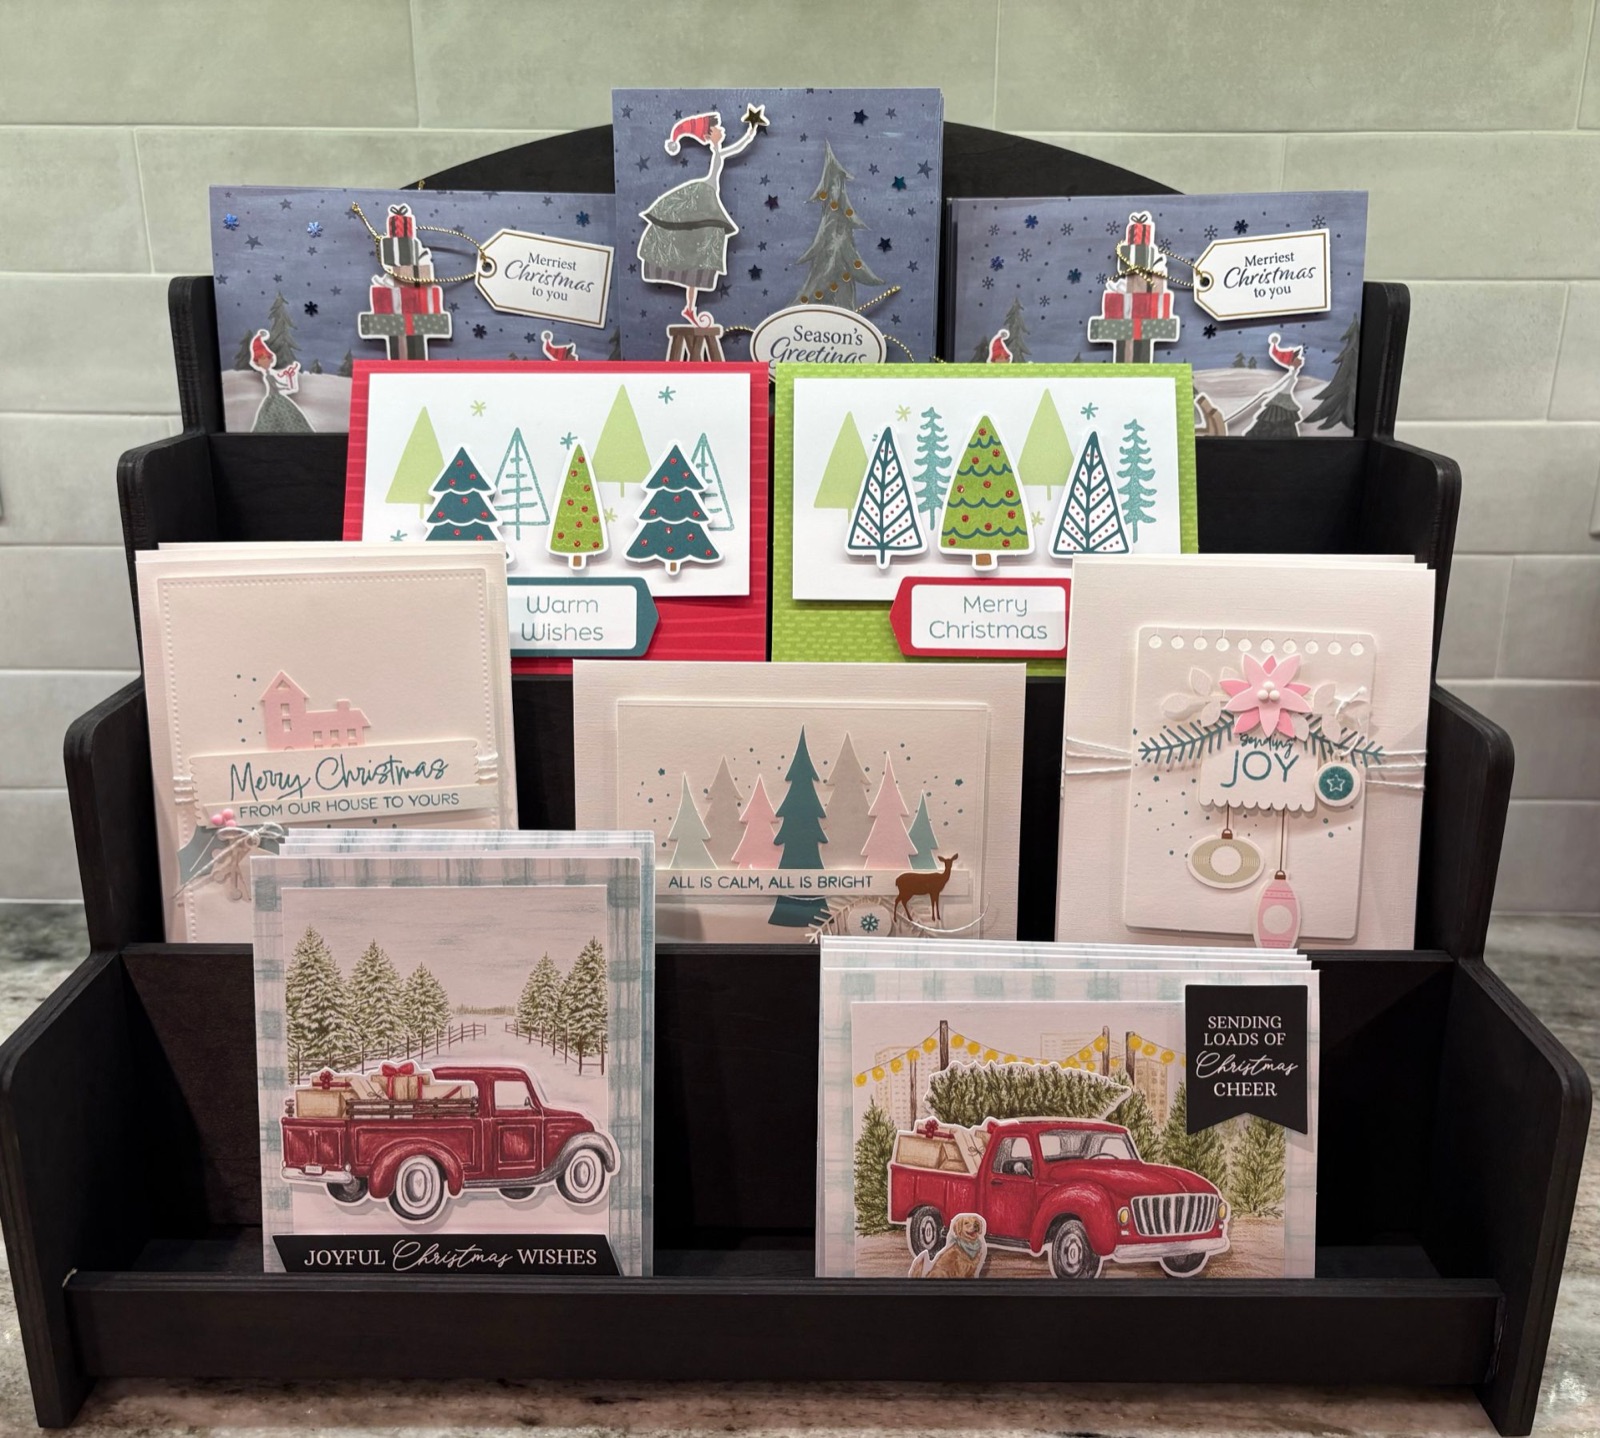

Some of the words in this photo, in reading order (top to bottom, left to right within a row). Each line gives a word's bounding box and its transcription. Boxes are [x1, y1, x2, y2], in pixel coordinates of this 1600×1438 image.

[528, 252, 577, 271] Merriest
[1244, 252, 1295, 267] Merriest
[504, 259, 595, 293] Christmas
[1223, 266, 1317, 289] Christmas
[532, 286, 543, 297] to
[546, 290, 568, 302] you
[1254, 288, 1266, 298] to
[1269, 285, 1291, 299] you
[793, 325, 863, 346] Season's
[526, 595, 599, 614] Warm
[963, 595, 1028, 617] Merry
[521, 622, 604, 642] Wishes
[929, 620, 1048, 640] Christmas
[230, 762, 311, 802] Merry
[315, 754, 449, 791] Christmas
[1220, 750, 1299, 788] JOY
[239, 804, 283, 819] FROM
[288, 801, 320, 815] OUR
[326, 797, 378, 813] HOUSE
[383, 796, 404, 809] TO
[408, 792, 460, 808] YOURS
[668, 876, 695, 889] ALL
[700, 876, 712, 888] IS
[717, 876, 764, 891] CALM,
[768, 876, 795, 888] ALL
[800, 876, 812, 888] IS
[817, 875, 873, 888] BRIGHT
[1208, 1015, 1282, 1029] SENDING
[1203, 1032, 1259, 1046] LOADS
[1264, 1032, 1287, 1046] OF
[1195, 1050, 1299, 1079] Christmas
[1213, 1082, 1278, 1097] CHEER
[304, 1249, 386, 1266] JOYFUL
[392, 1239, 513, 1271] Christmas
[517, 1248, 597, 1265] WISHES
